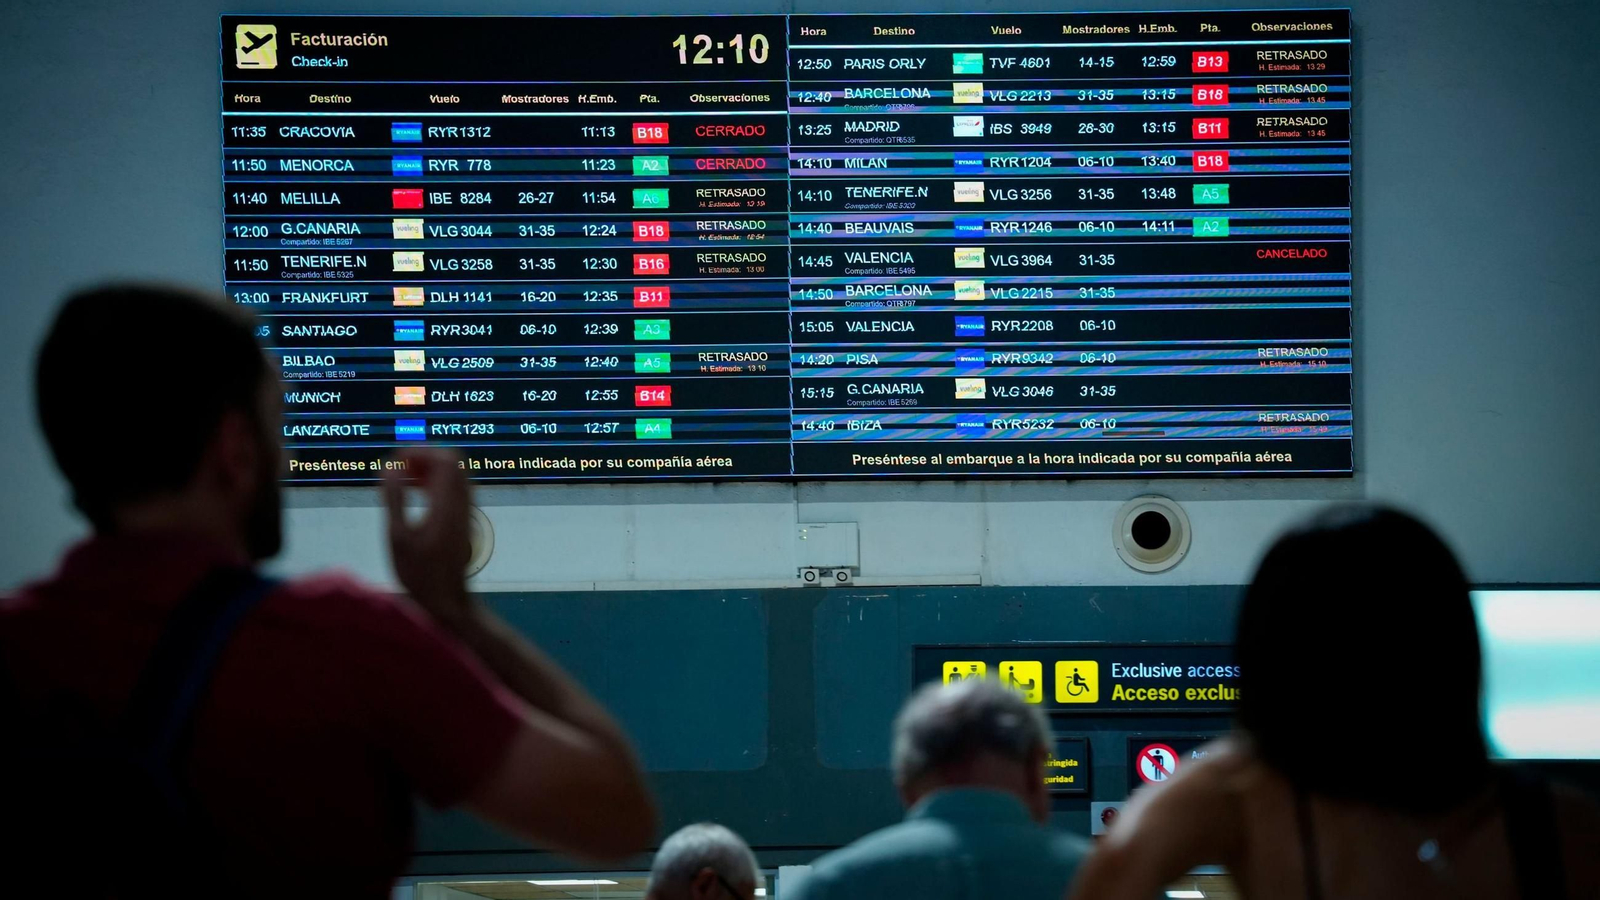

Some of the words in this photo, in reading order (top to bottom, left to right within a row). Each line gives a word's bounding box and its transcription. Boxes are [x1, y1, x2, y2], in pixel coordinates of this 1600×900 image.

[801, 27, 826, 36] Hora
[874, 27, 915, 36] Destino
[991, 26, 1021, 35] Vuelo
[1062, 25, 1130, 34] Mostradores
[1200, 24, 1220, 32] Pta.
[1252, 22, 1333, 31] Observaciones
[291, 32, 388, 46] Facturación
[673, 34, 769, 64] 12:10
[292, 56, 348, 67] Check-in
[798, 59, 831, 69] 12:50
[844, 59, 884, 69] PARIS
[889, 59, 926, 69] ORLY
[1079, 57, 1114, 68] 14-15
[1142, 57, 1176, 67] 12:59
[1197, 57, 1222, 67] B13
[1257, 51, 1327, 60] RETRASADO
[235, 94, 261, 103] Hora
[310, 94, 351, 103] Destino
[430, 94, 460, 103] Vuelo
[502, 94, 569, 103] Mostradores
[690, 93, 770, 102] Observaciones
[798, 92, 831, 102] 12:40
[844, 88, 930, 98] BARCELONA
[1078, 90, 1114, 100] 31-35
[1142, 90, 1176, 100] 13:15
[1257, 84, 1327, 94] RETRASADO
[232, 127, 266, 137] 11:35
[279, 127, 355, 137] CRACOVIA
[637, 128, 662, 138] B18
[696, 126, 765, 136] CERRADO
[798, 125, 831, 135] 13:25
[844, 122, 900, 132] MADRID
[1198, 123, 1222, 133] B11
[1257, 117, 1327, 127] RETRASADO
[232, 160, 266, 171] 11:50
[280, 160, 354, 171] MENORCA
[429, 160, 458, 170] RYR
[467, 160, 491, 171] 778
[582, 160, 615, 170] 11:23
[642, 160, 658, 170] A2
[696, 158, 765, 169] CERRADO
[798, 158, 832, 168] 14:10
[844, 158, 887, 168] MILAN
[1078, 157, 1114, 167] 06-10
[1141, 156, 1176, 166] 13:40
[1198, 156, 1223, 167] B18
[233, 193, 267, 204] 11:40
[281, 193, 340, 204] MELILLA
[430, 193, 452, 204] IBE
[460, 193, 491, 204] 8284
[518, 192, 554, 203] 26-27
[582, 192, 616, 203] 11:54
[643, 193, 659, 203] A6
[696, 188, 765, 197] RETRASADO
[798, 190, 832, 201] 14:10
[845, 187, 928, 198] TENERIFE.N
[1078, 189, 1114, 199] 31-35
[1142, 188, 1176, 199] 13:48
[1202, 189, 1219, 199] A5
[233, 226, 268, 237] 12:00
[281, 223, 360, 234] G.CANARIA
[519, 225, 555, 236] 31-35
[582, 225, 617, 236] 12:24
[639, 226, 664, 236] B18
[696, 221, 766, 230] RETRASADO
[798, 223, 832, 234] 14:40
[845, 223, 914, 233] BEAUVAIS
[1079, 222, 1114, 232] 06-10
[1142, 221, 1175, 232] 14:11
[1203, 222, 1219, 232] A2
[234, 259, 268, 271] 11:50
[281, 256, 366, 267] TENERIFE.N
[520, 258, 555, 270] 31-35
[583, 258, 617, 269] 12:30
[639, 259, 664, 270] B16
[697, 253, 766, 262] RETRASADO
[798, 256, 832, 267] 14:45
[845, 252, 913, 263] VALENCIA
[1079, 255, 1115, 265] 31-35
[1257, 249, 1327, 258] CANCELADO
[234, 292, 269, 303] 13:00
[282, 292, 368, 303] FRANKFURT
[521, 292, 556, 302] 16-20
[583, 291, 618, 301] 12:35
[640, 292, 662, 302] B11
[799, 289, 833, 300] 14:50
[846, 285, 932, 296] BARCELONA
[1080, 288, 1115, 298] 31-35
[282, 326, 357, 336] SANTIAGO
[520, 324, 556, 334] 06-10
[584, 324, 618, 334] 12:39
[800, 322, 834, 332] 15:05
[846, 322, 914, 332] VALENCIA
[1080, 320, 1115, 331] 06-10
[283, 356, 335, 366] BILBAO
[520, 357, 557, 367] 31-35
[584, 357, 618, 367] 12:40
[698, 352, 768, 361] RETRASADO
[847, 354, 878, 364] PISA
[1080, 353, 1116, 363] 06-10
[1258, 348, 1328, 357] RETRASADO
[284, 392, 340, 402] MUNICH
[523, 391, 557, 401] 16-20
[585, 390, 618, 400] 12:55
[640, 391, 665, 401] B14
[847, 384, 923, 394] G.CANARIA
[1080, 386, 1116, 396] 31-35
[847, 420, 882, 430] IBIZA
[1258, 413, 1329, 421] RETRASADO
[284, 425, 369, 436] LANZAROTE
[521, 423, 557, 433] 06-10
[584, 423, 619, 433] 12:57
[645, 424, 660, 433] A4
[290, 459, 365, 472] Preséntese
[370, 459, 381, 470] al
[468, 459, 480, 469] la
[485, 458, 515, 469] hora
[519, 458, 576, 468] indicada
[581, 458, 602, 470] por
[607, 458, 622, 468] su
[627, 456, 692, 470] compañía
[696, 457, 732, 467] aérea
[853, 454, 927, 466] Preséntese
[931, 454, 942, 464] al
[946, 454, 1013, 467] embarque
[1017, 455, 1024, 464] a
[1029, 454, 1040, 464] la
[1044, 453, 1074, 463] hora
[1079, 453, 1135, 463] indicada
[1140, 453, 1161, 465] por
[1166, 453, 1181, 462] su
[1186, 451, 1251, 464] compañía
[1256, 452, 1292, 462] aérea
[1112, 663, 1182, 677] Exclusive
[1187, 664, 1241, 677] access
[1112, 684, 1179, 700] Acceso
